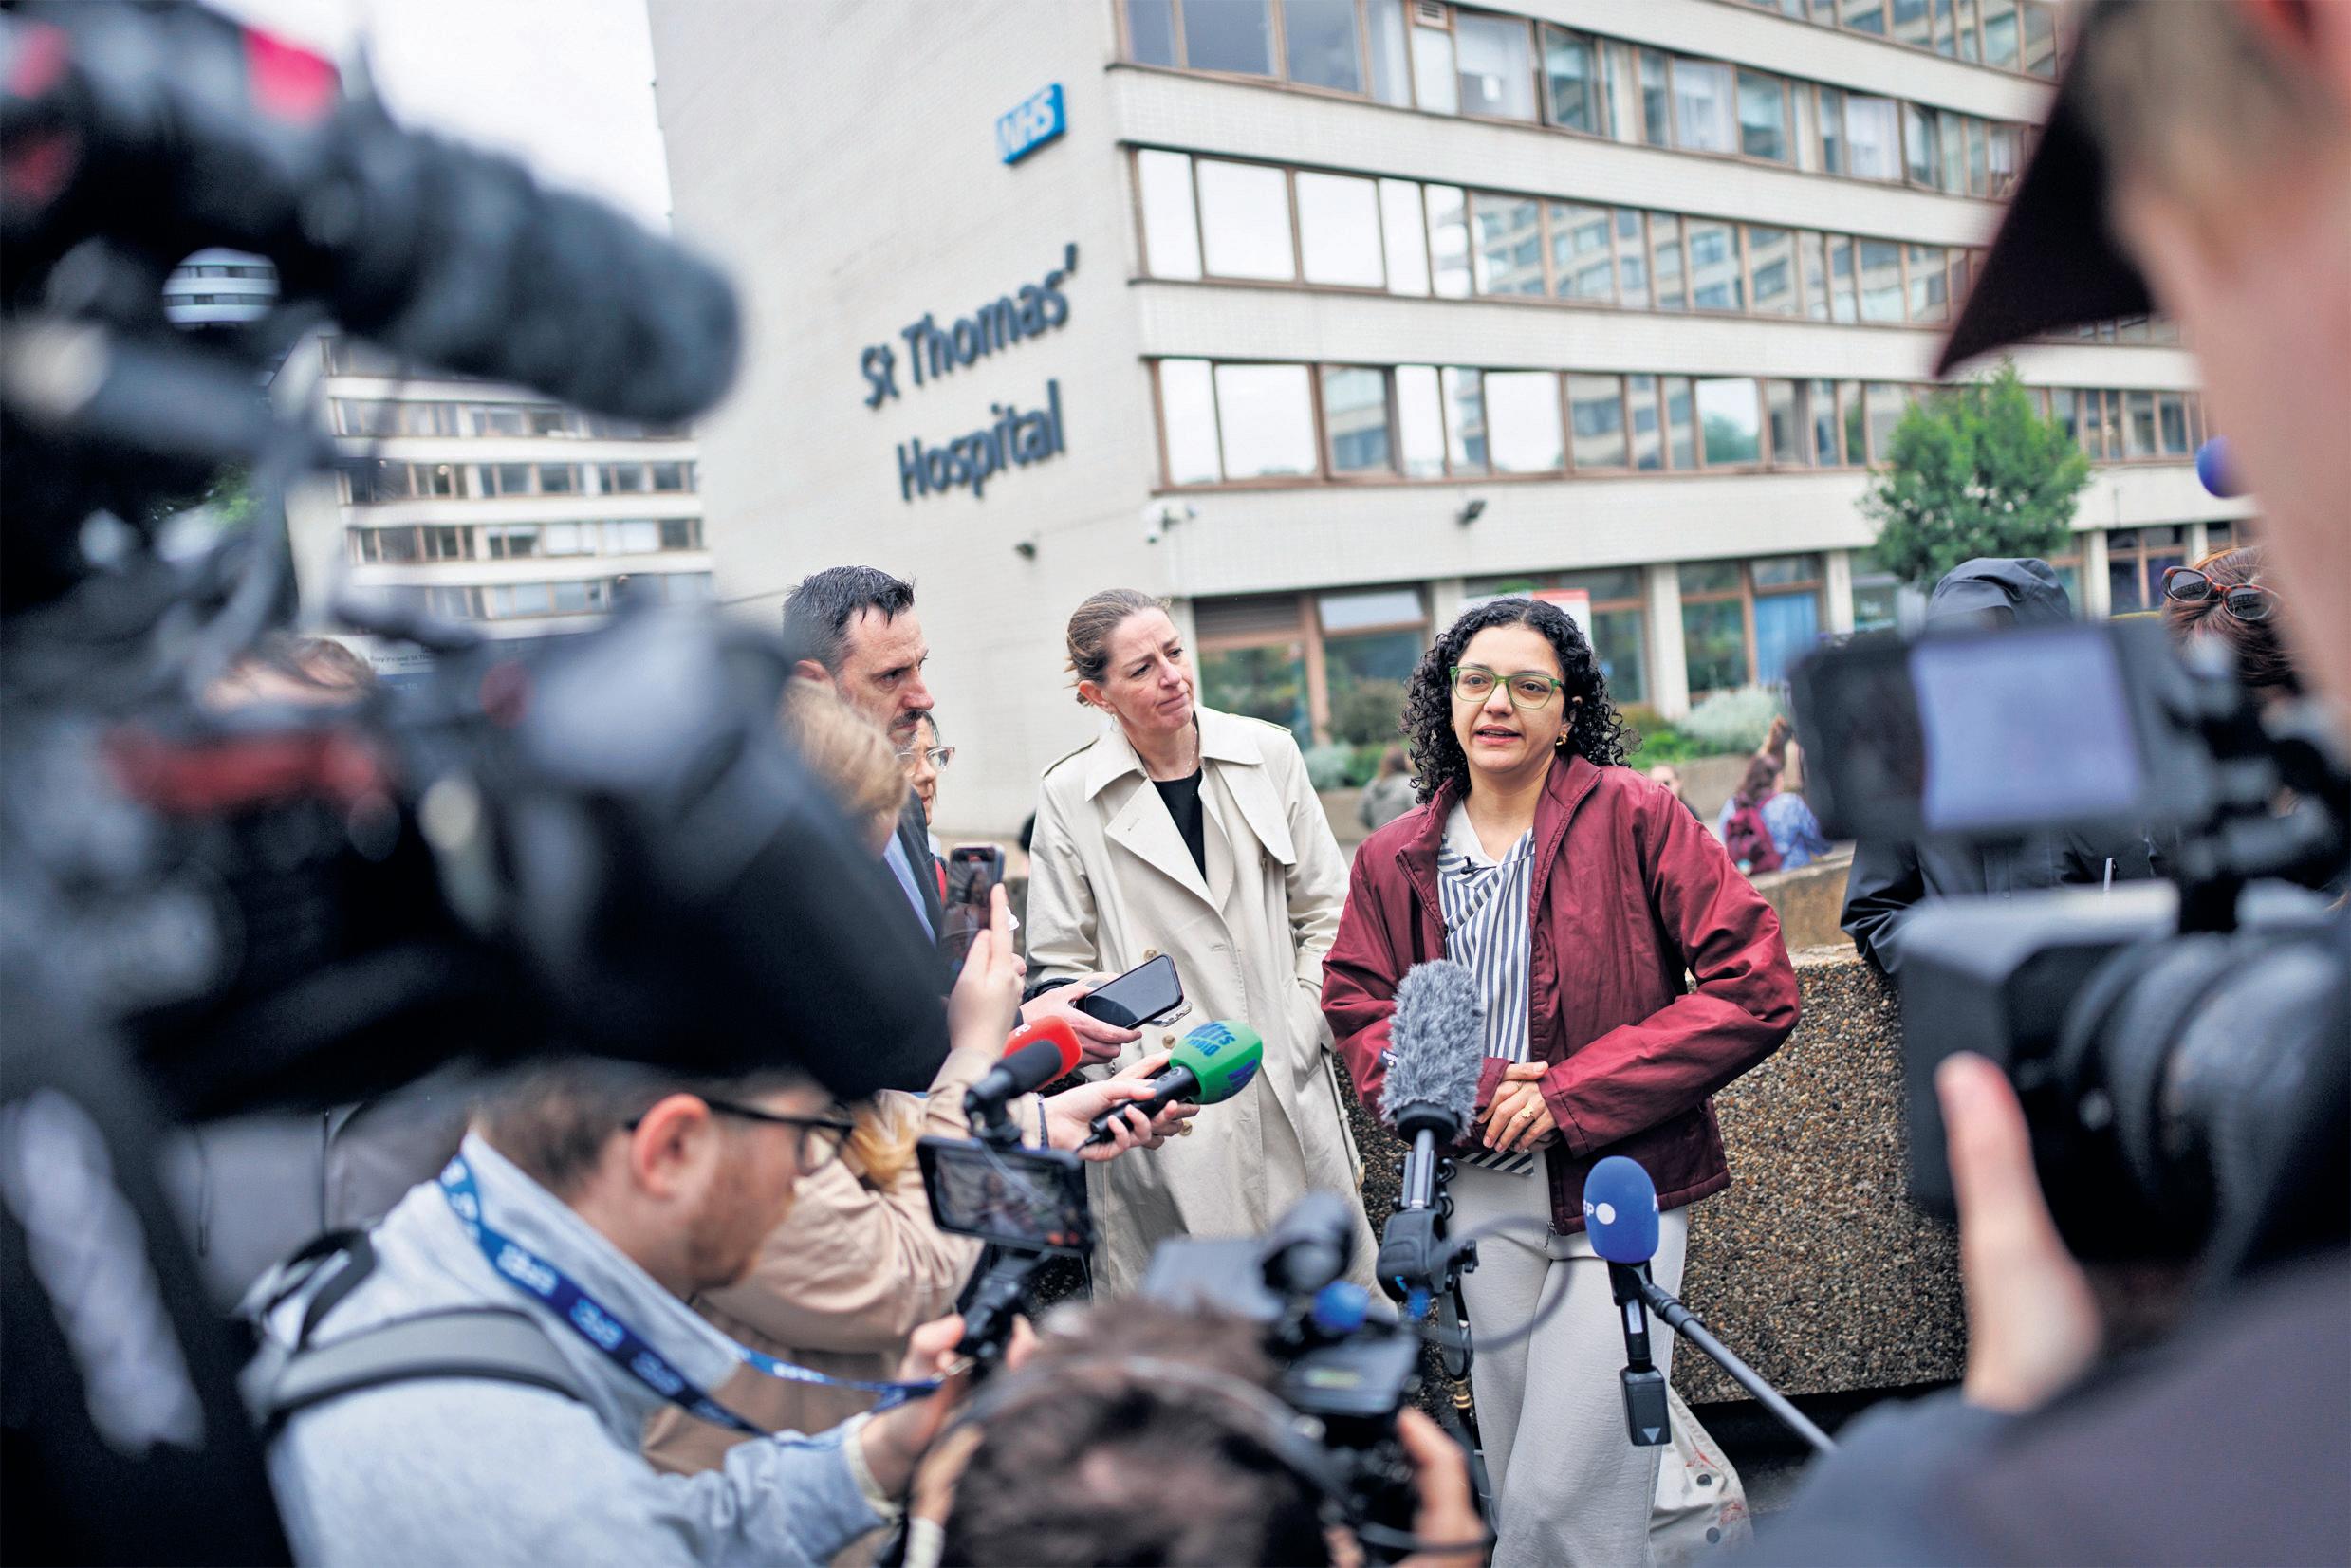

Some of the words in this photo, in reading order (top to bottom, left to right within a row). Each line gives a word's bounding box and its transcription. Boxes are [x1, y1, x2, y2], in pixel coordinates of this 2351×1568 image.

[997, 89, 1057, 155] NHS
[861, 345, 899, 409] St
[902, 243, 1078, 386] Thomas'
[898, 378, 1065, 501] Hospital
